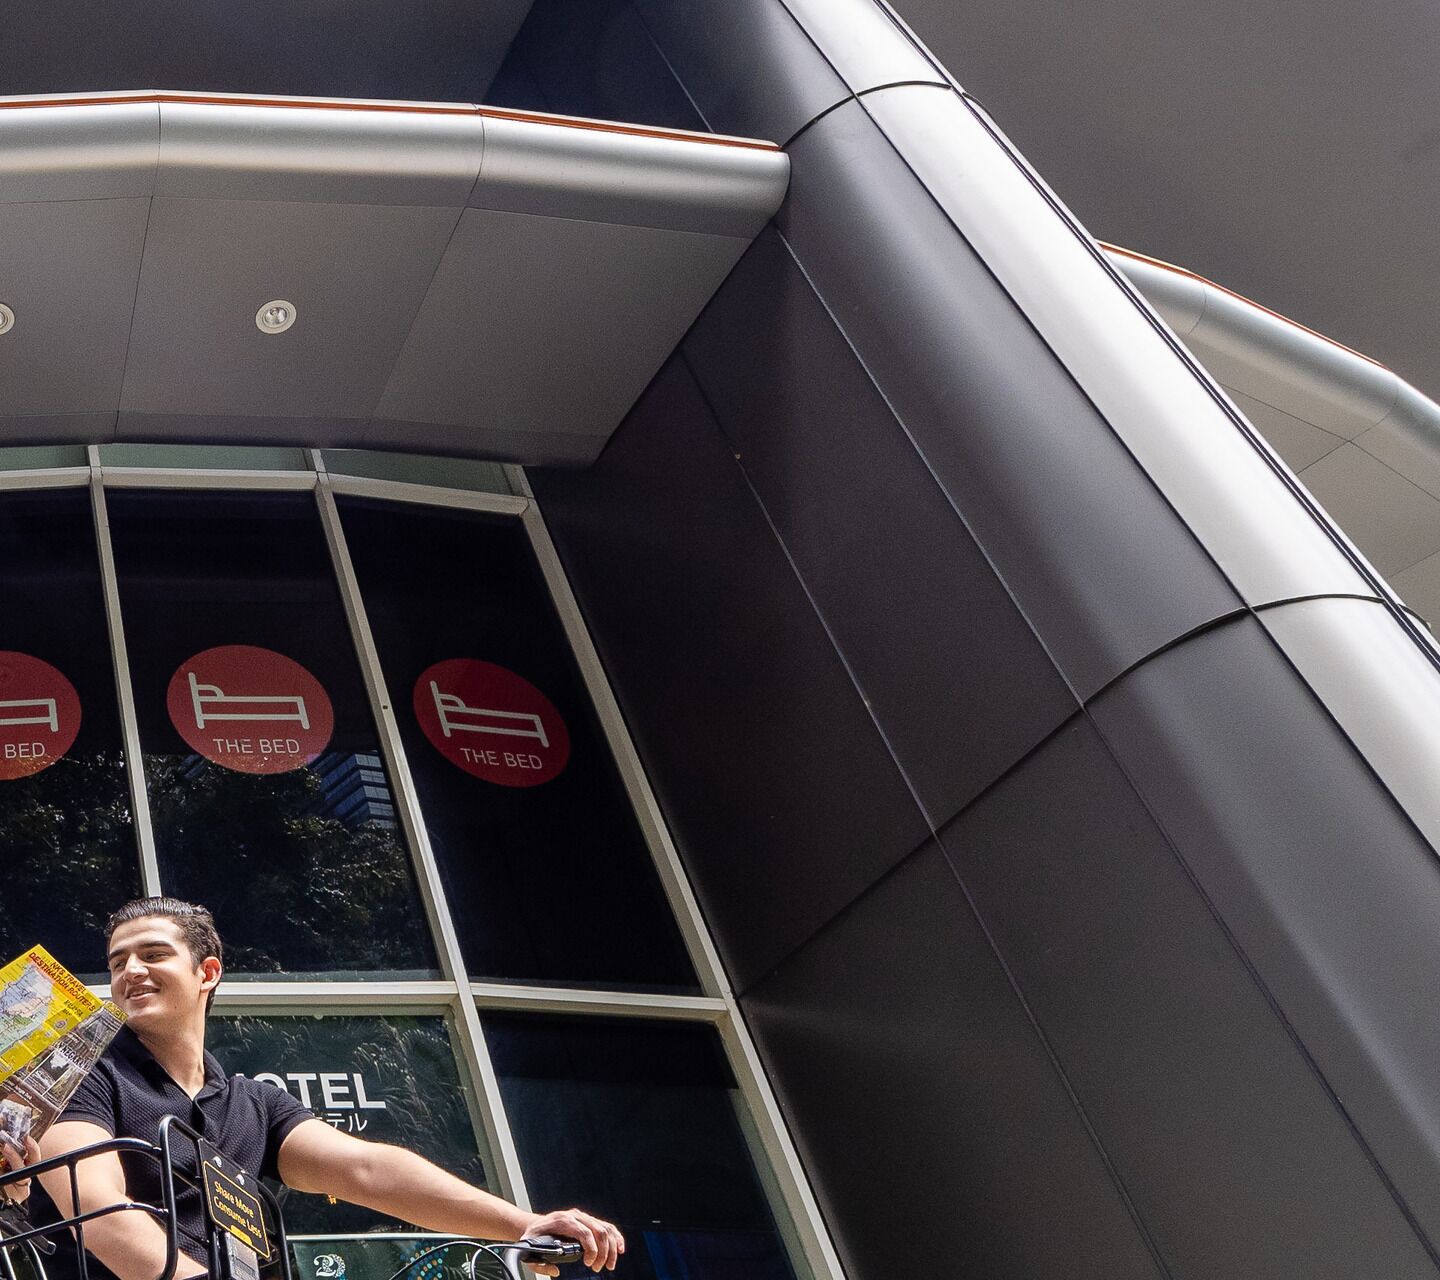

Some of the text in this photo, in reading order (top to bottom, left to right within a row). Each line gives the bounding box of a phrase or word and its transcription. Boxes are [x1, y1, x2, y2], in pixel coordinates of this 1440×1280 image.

[5, 743, 46, 759] BED
[214, 738, 300, 754] THE BED
[460, 746, 543, 770] THE BED
[28, 951, 69, 991] DESTINATION
[69, 986, 96, 1012] ROUTERS
[64, 972, 87, 994] TRAVEL
[213, 1180, 254, 1219] Share More
[213, 1194, 262, 1239] Consume Less
